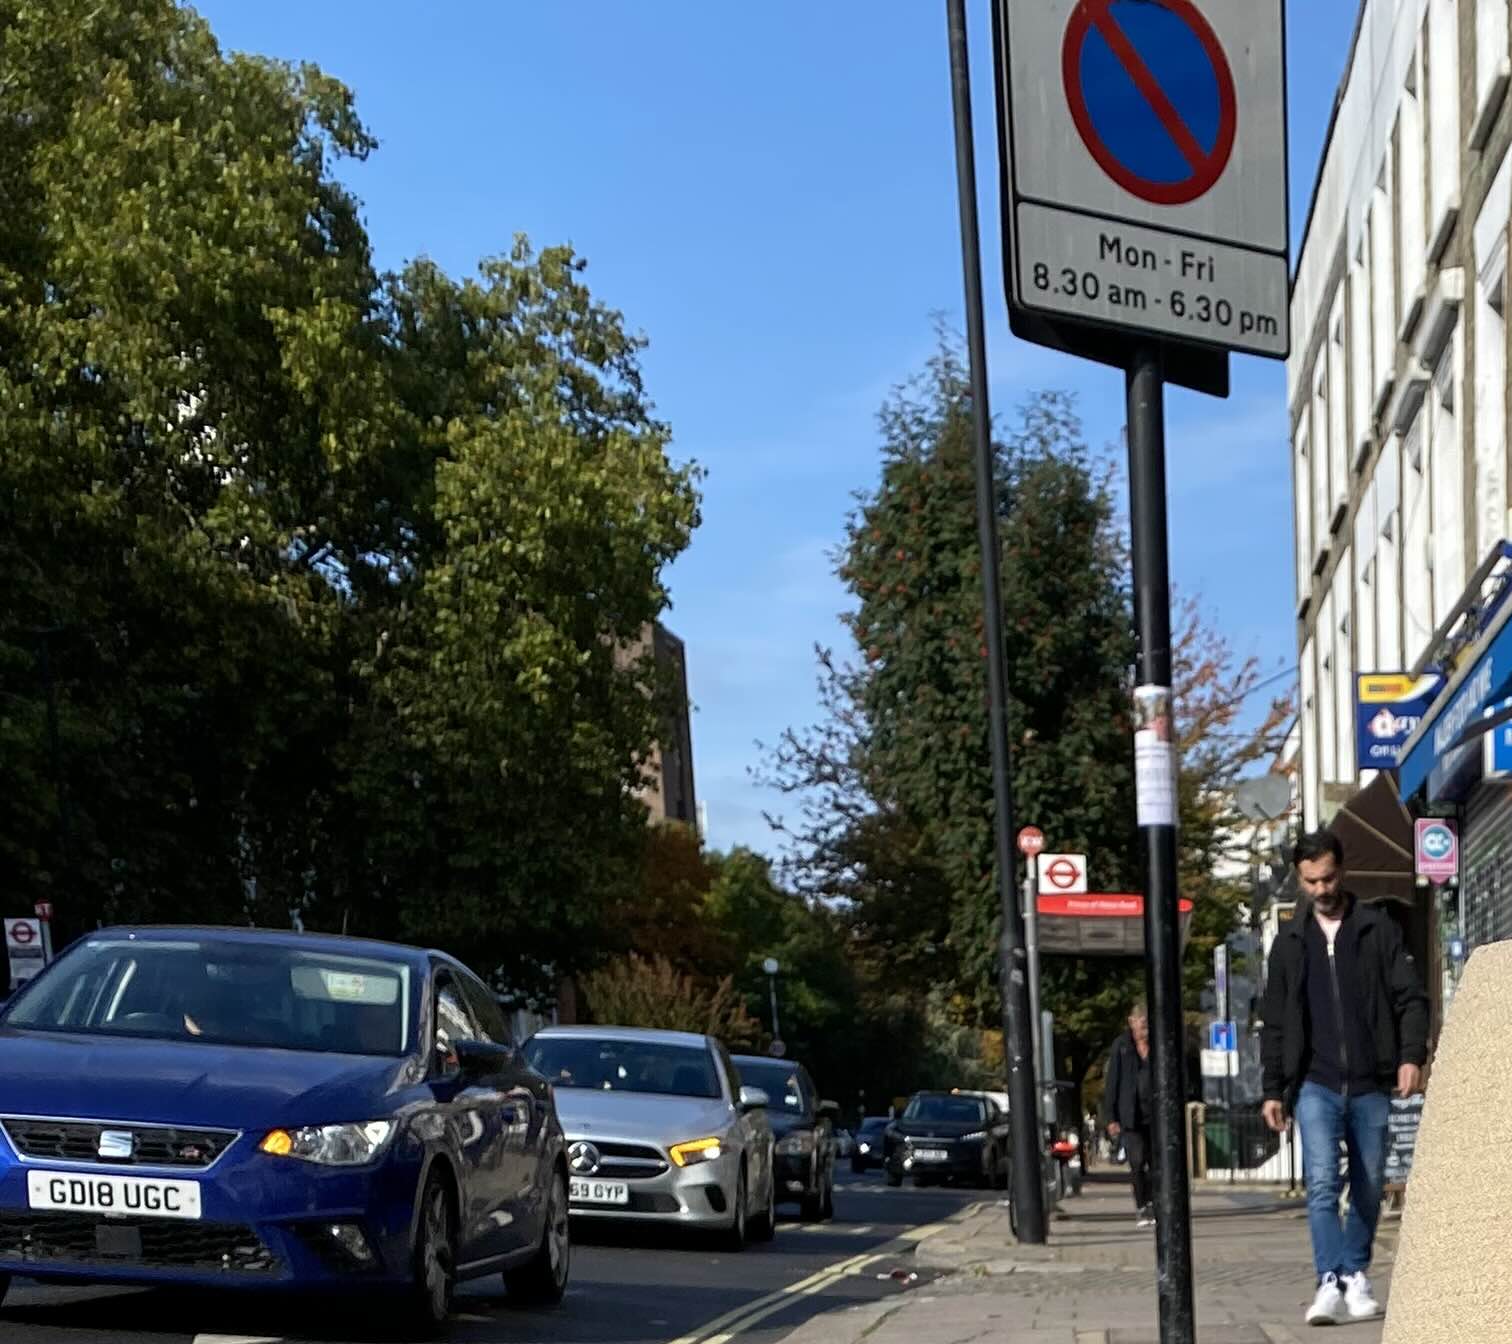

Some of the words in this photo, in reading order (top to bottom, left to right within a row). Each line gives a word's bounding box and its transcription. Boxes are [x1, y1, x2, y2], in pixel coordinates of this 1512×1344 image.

[1099, 233, 1157, 271] Mon
[1181, 252, 1215, 283] Fri
[1032, 262, 1100, 300] 8.30
[1107, 281, 1147, 310] am
[1170, 290, 1233, 326] 6.30
[1240, 312, 1278, 336] pm
[49, 1178, 114, 1207] GD18
[123, 1182, 181, 1212] UGC
